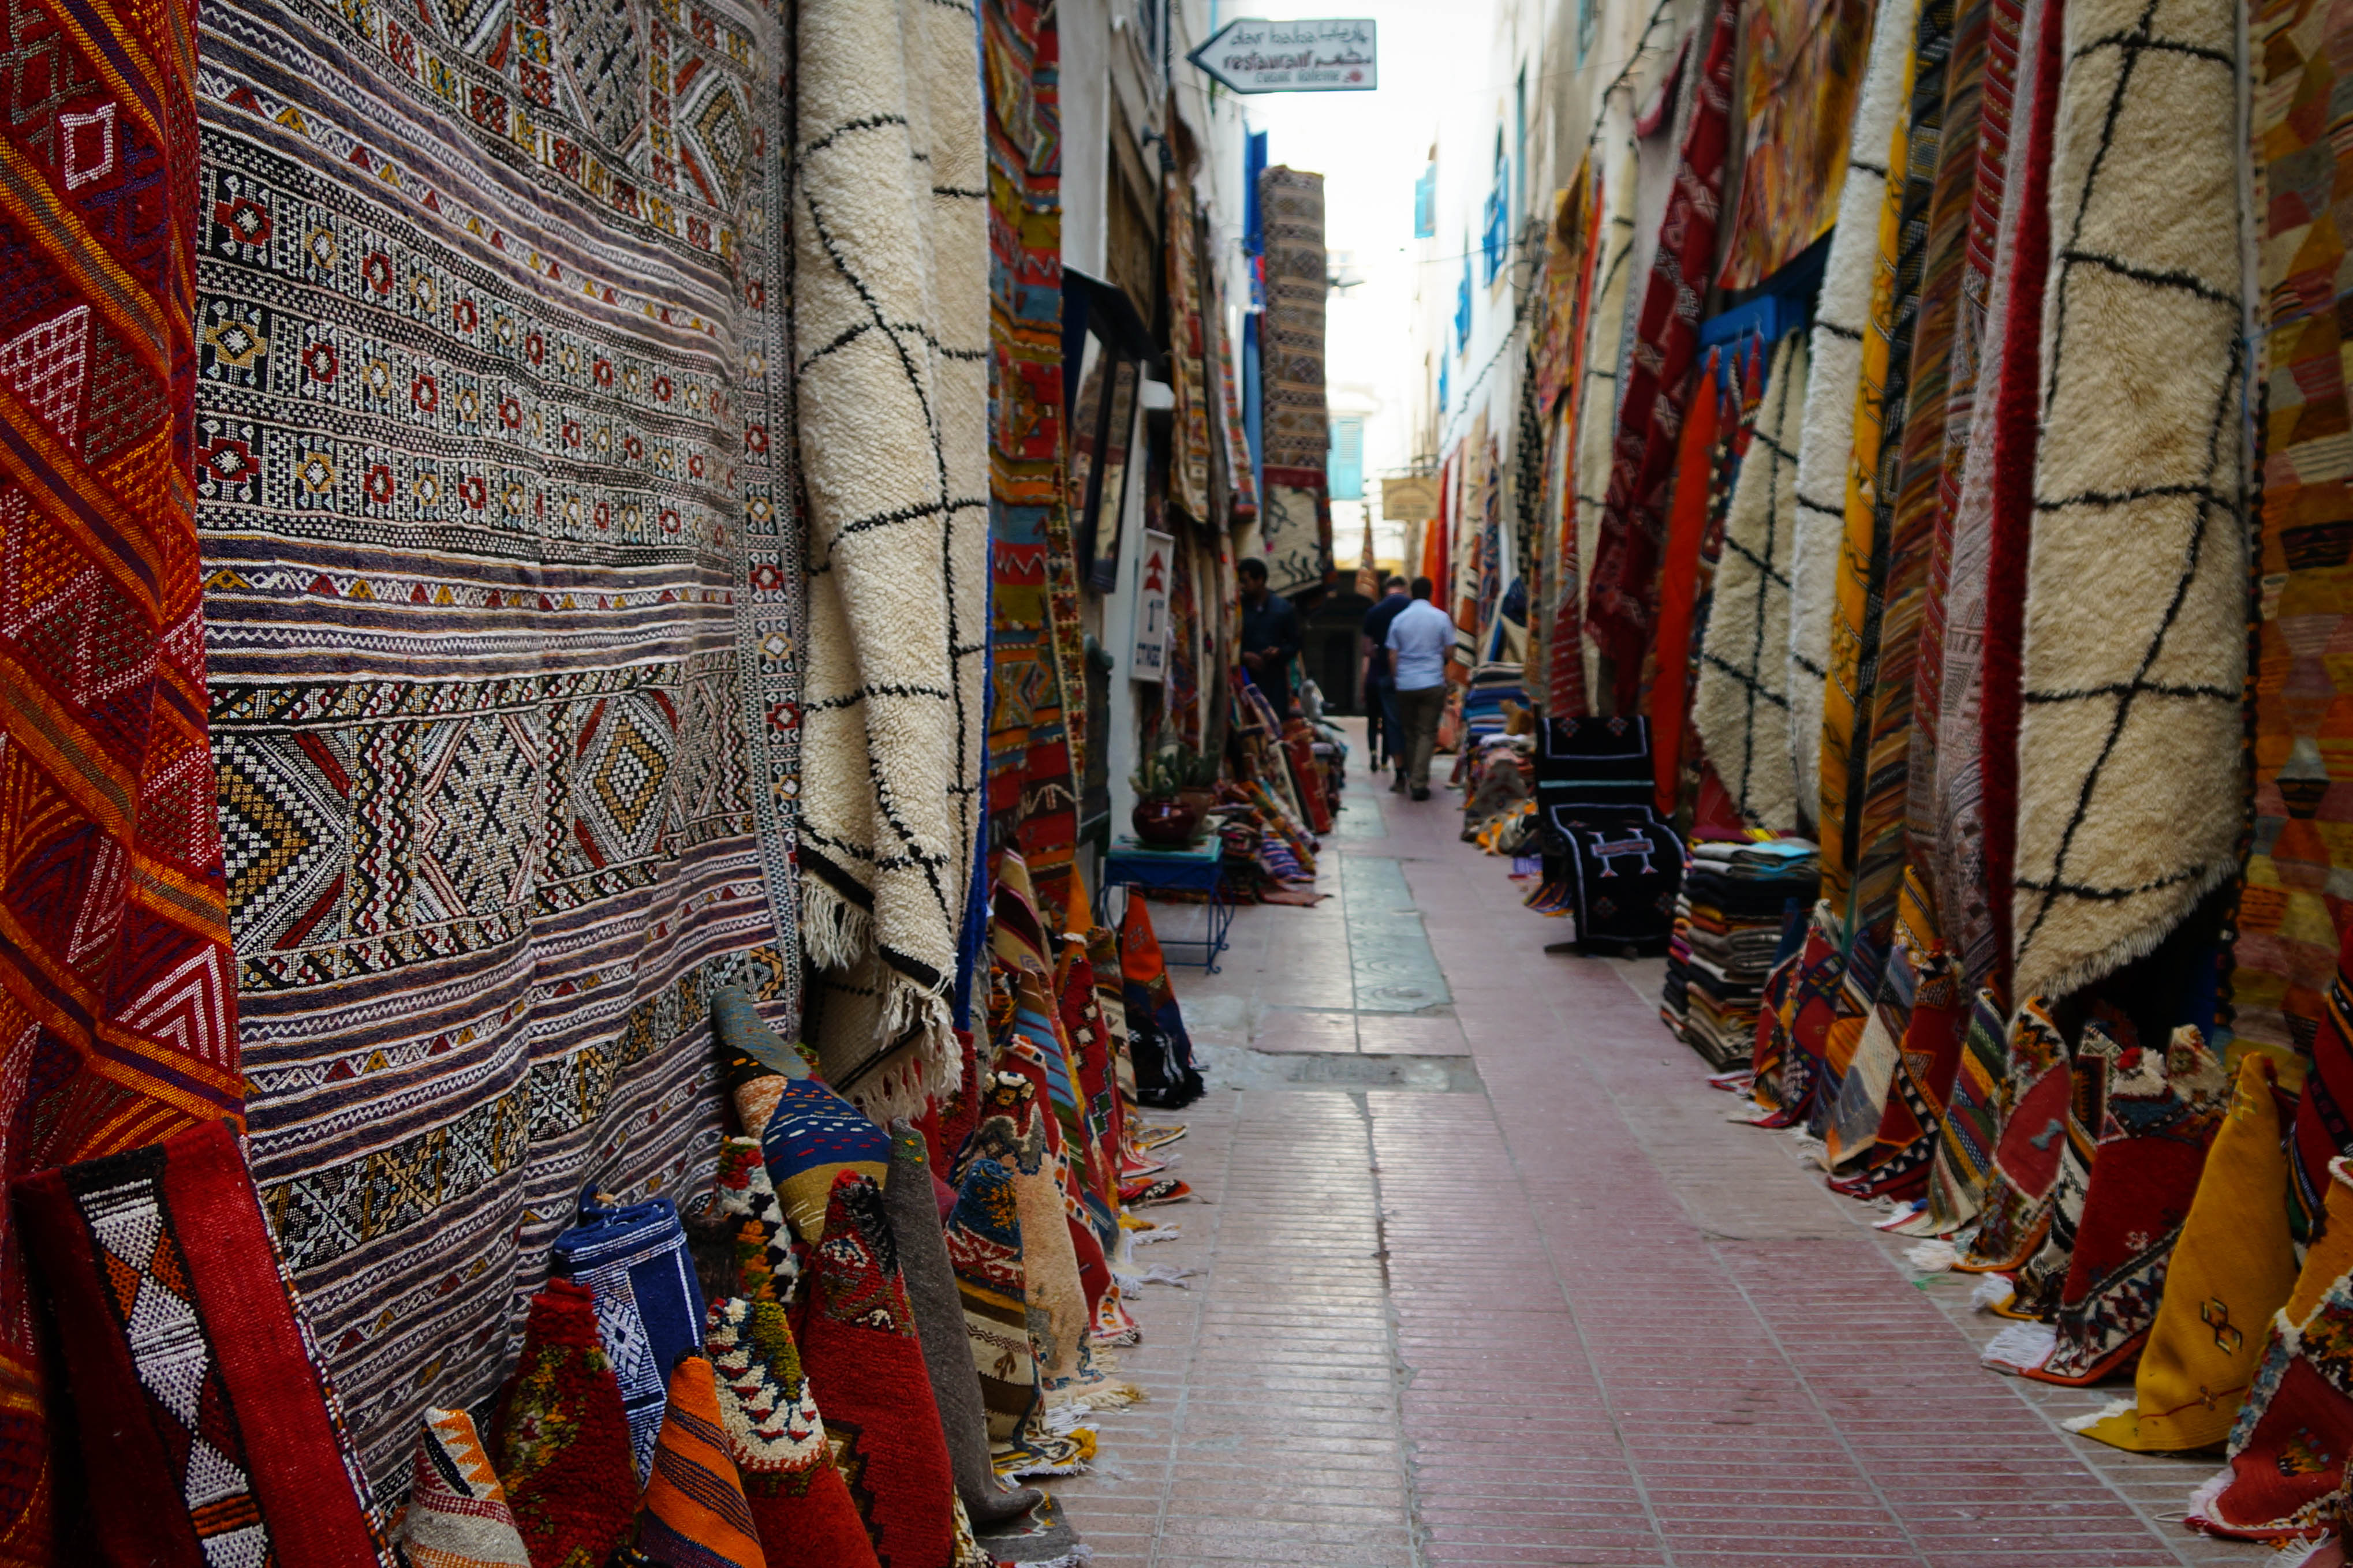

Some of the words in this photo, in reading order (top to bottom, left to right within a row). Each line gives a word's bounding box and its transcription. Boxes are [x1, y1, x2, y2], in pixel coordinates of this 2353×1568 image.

[1231, 25, 1263, 45] dar
[1270, 25, 1317, 44] baba
[1223, 50, 1313, 70] restaurant
